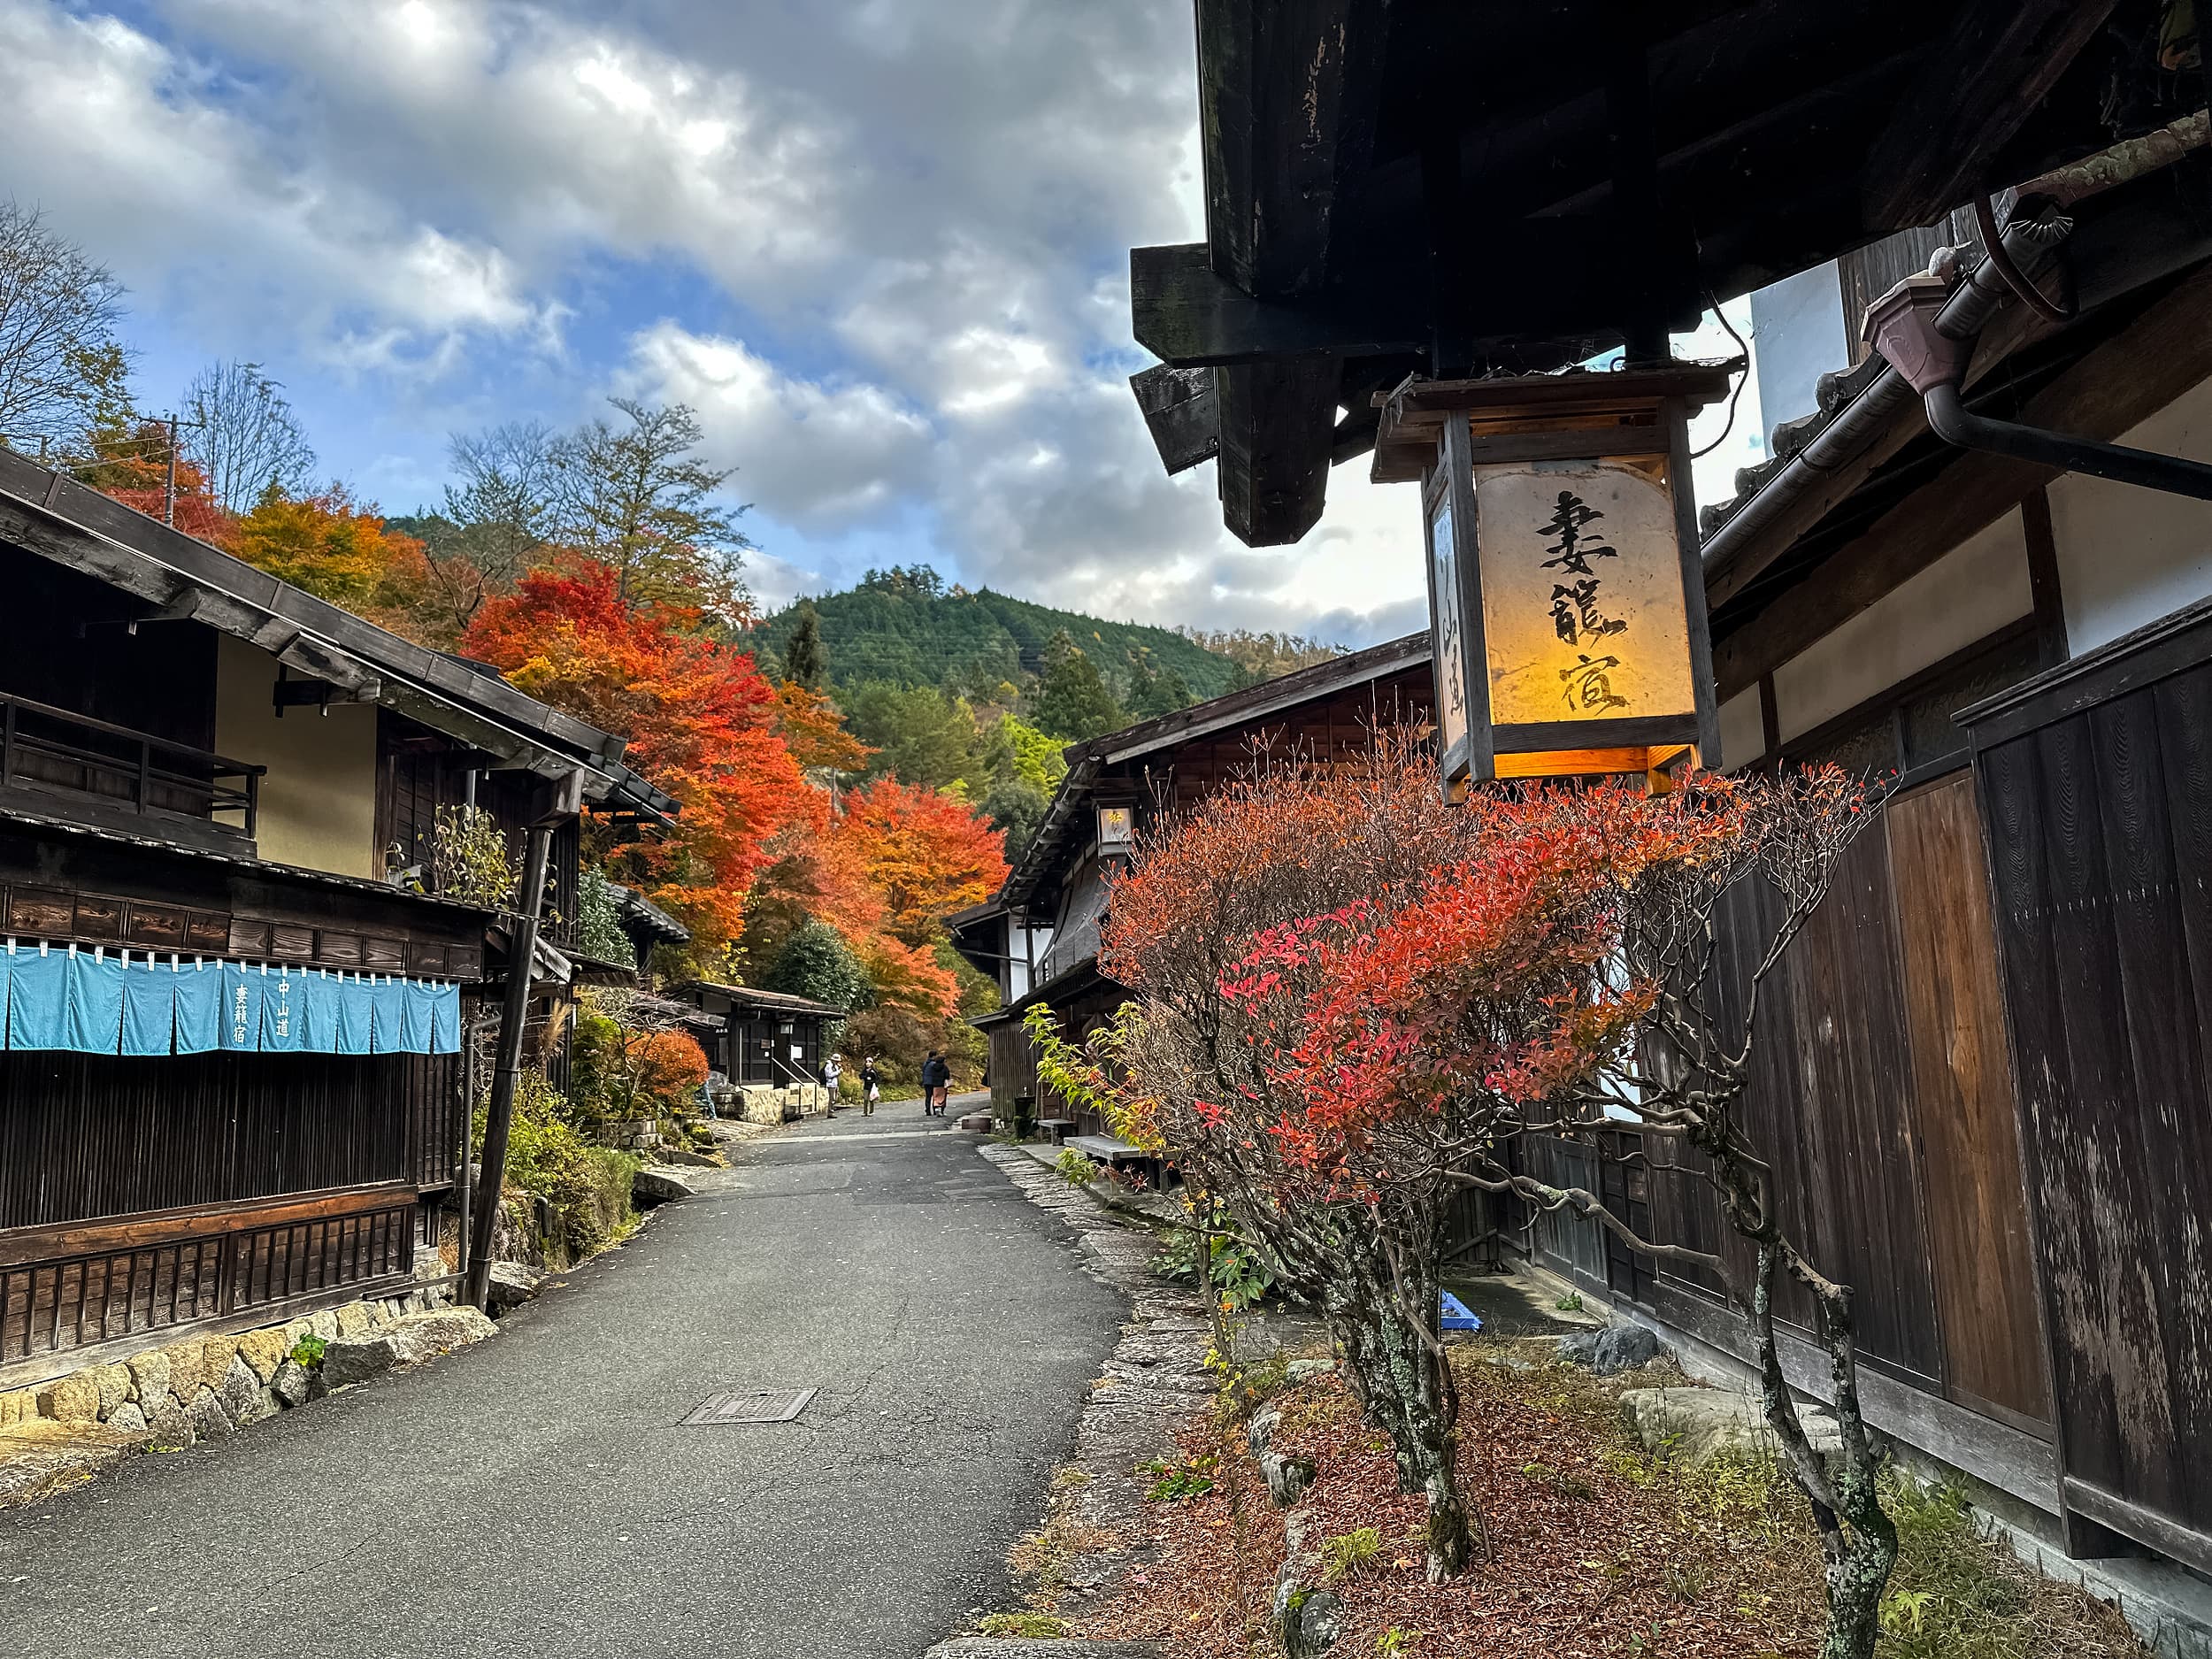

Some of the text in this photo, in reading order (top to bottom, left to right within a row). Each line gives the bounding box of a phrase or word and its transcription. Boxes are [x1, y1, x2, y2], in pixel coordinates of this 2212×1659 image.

[1537, 489, 1631, 715] 妻籠宿
[233, 983, 249, 1044] 妻籠宿
[276, 978, 290, 1038] 中山道
